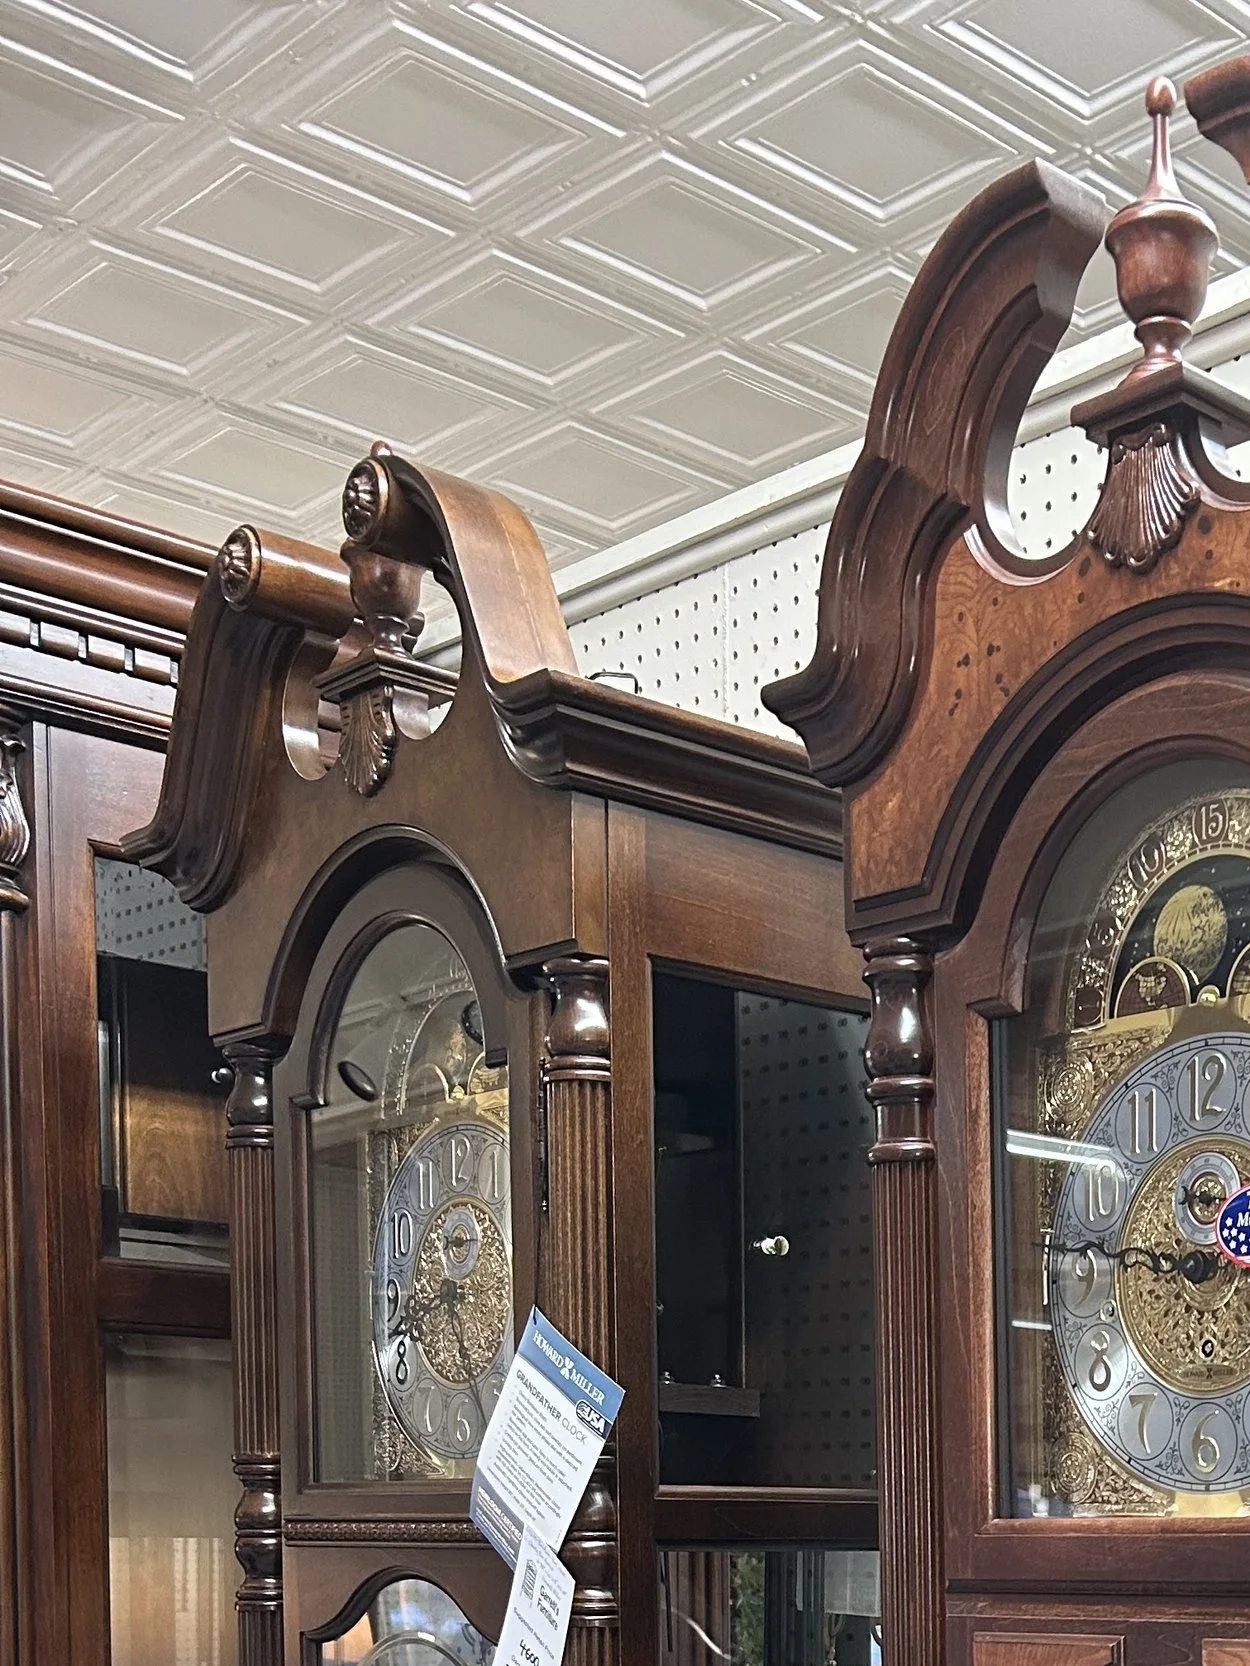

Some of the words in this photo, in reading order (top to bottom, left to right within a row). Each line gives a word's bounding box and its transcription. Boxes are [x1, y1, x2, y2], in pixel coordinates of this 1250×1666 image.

[1200, 803, 1224, 840] 15
[1186, 1053, 1227, 1123] 12
[1127, 1087, 1159, 1156] 11
[418, 1160, 435, 1210] 11
[449, 1135, 471, 1187] 12
[490, 1149, 500, 1199] 1
[1084, 1159, 1119, 1222] 10
[392, 1209, 413, 1260] 10
[387, 1278, 400, 1322] 9
[1071, 1247, 1098, 1305] 9
[396, 1339, 409, 1386] 8
[532, 1330, 565, 1369] HOWARD
[568, 1369, 606, 1407] MILLER
[1088, 1329, 1112, 1392] 8
[515, 1368, 562, 1422] GRANDFATHER
[561, 1417, 588, 1446] CLOCK
[583, 1405, 606, 1435] USA
[1128, 1391, 1159, 1455] 7
[1190, 1409, 1221, 1474] 6
